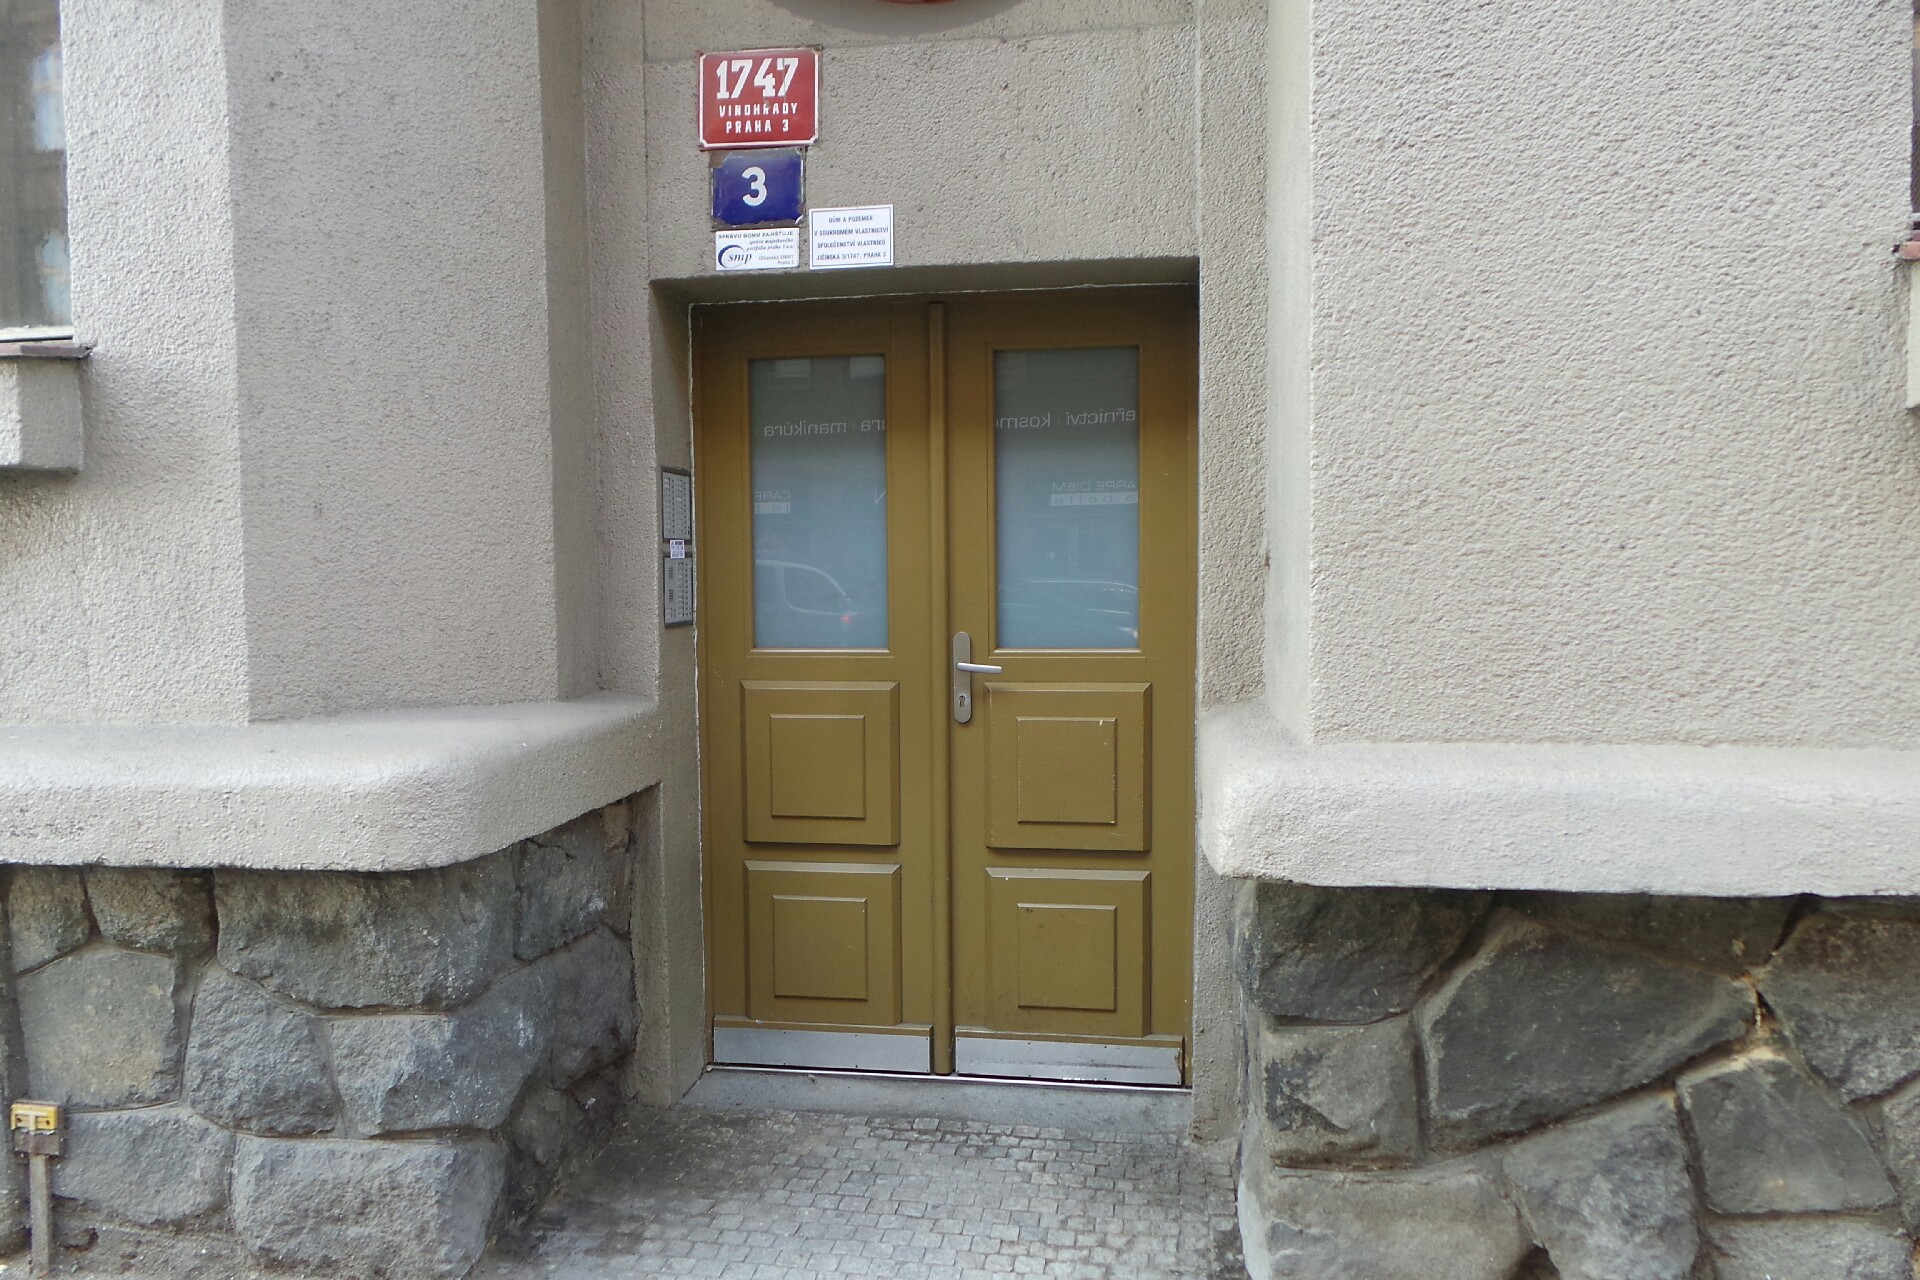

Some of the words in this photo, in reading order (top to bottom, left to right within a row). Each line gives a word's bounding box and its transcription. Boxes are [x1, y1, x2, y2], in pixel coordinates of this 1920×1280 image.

[716, 58, 798, 99] 1747
[719, 102, 798, 118] VINOHRADY
[726, 120, 772, 134] PRAHA
[782, 119, 789, 132] 3
[742, 166, 767, 206] 3
[728, 253, 752, 264] smp
